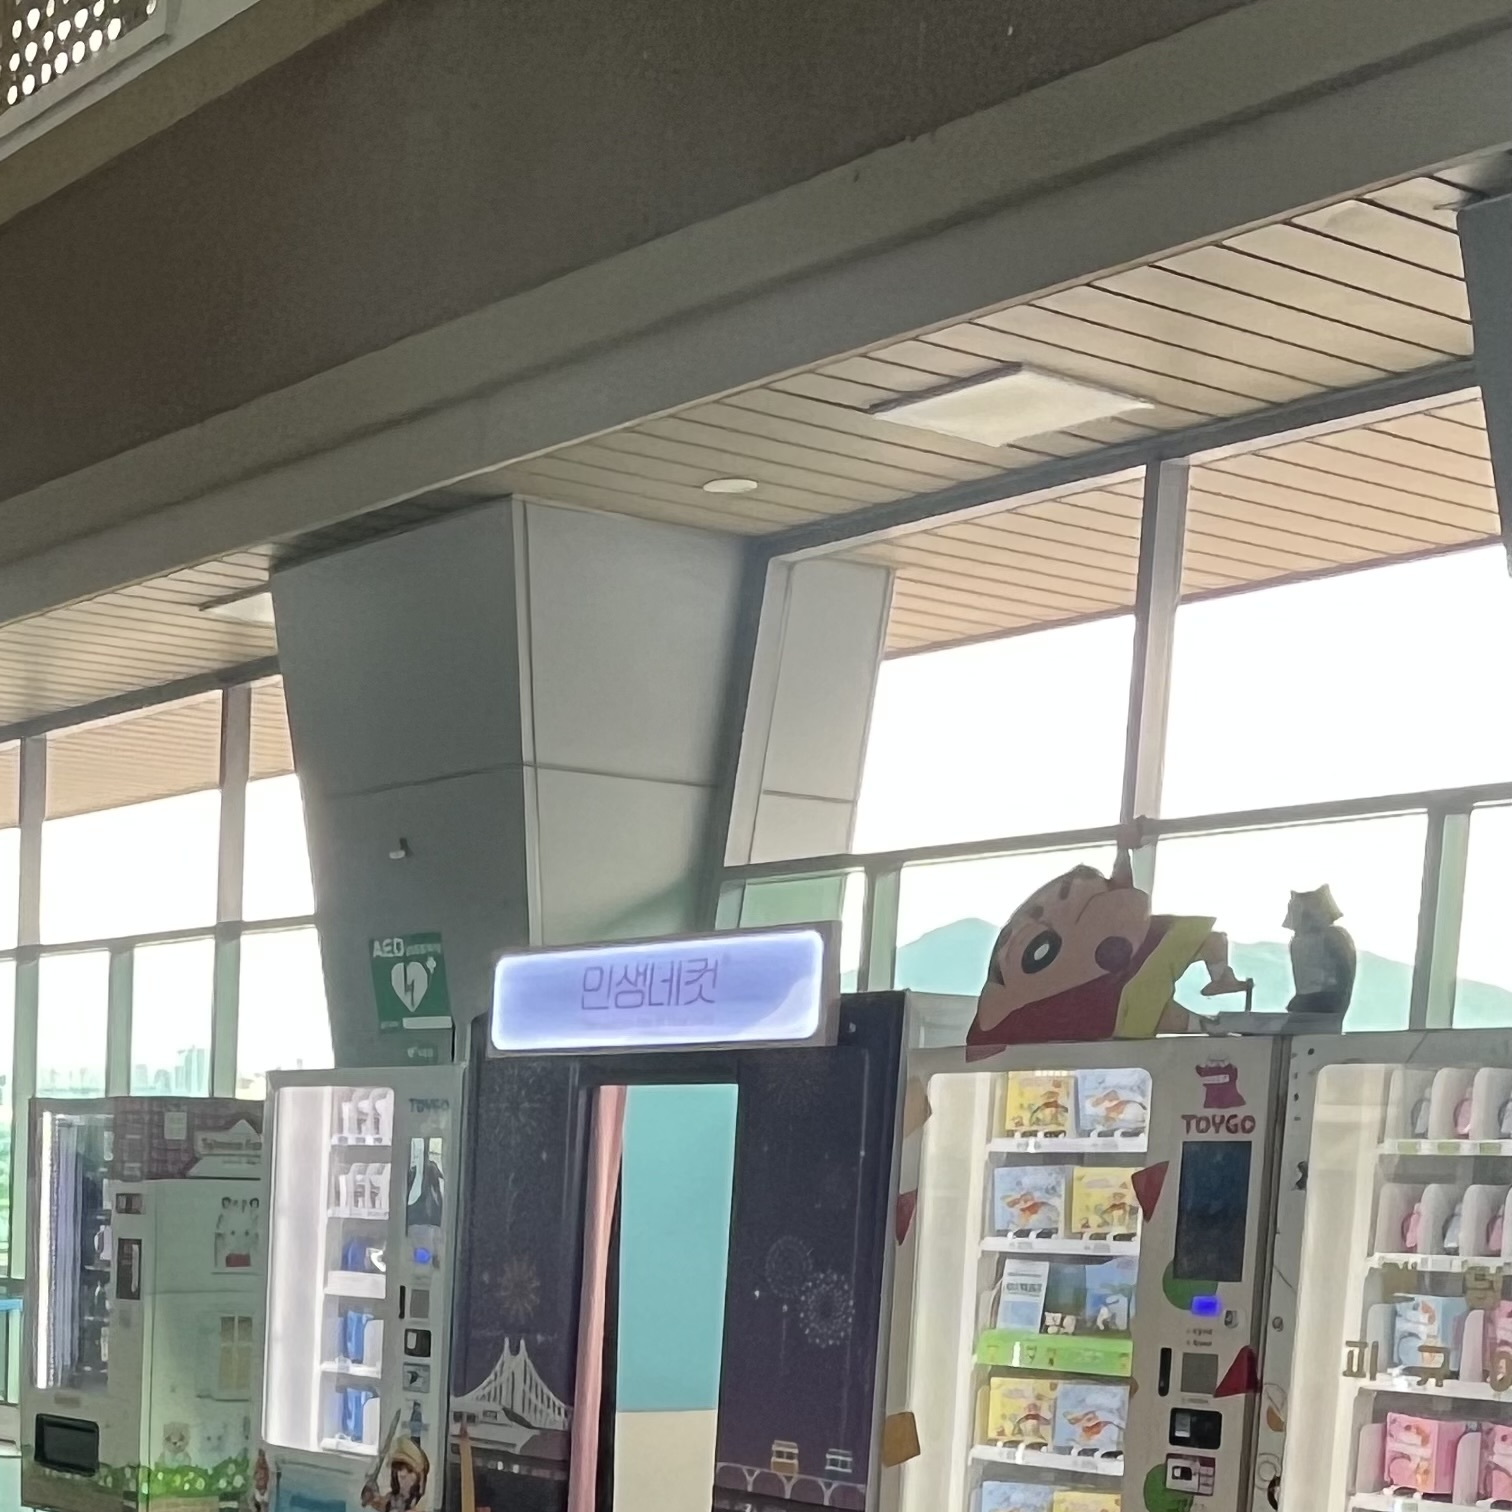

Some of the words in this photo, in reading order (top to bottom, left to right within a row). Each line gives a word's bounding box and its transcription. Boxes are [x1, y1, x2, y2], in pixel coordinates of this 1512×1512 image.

[373, 937, 404, 957] AED
[581, 957, 719, 1010] 인생네컷
[1180, 1113, 1256, 1135] TOYGO
